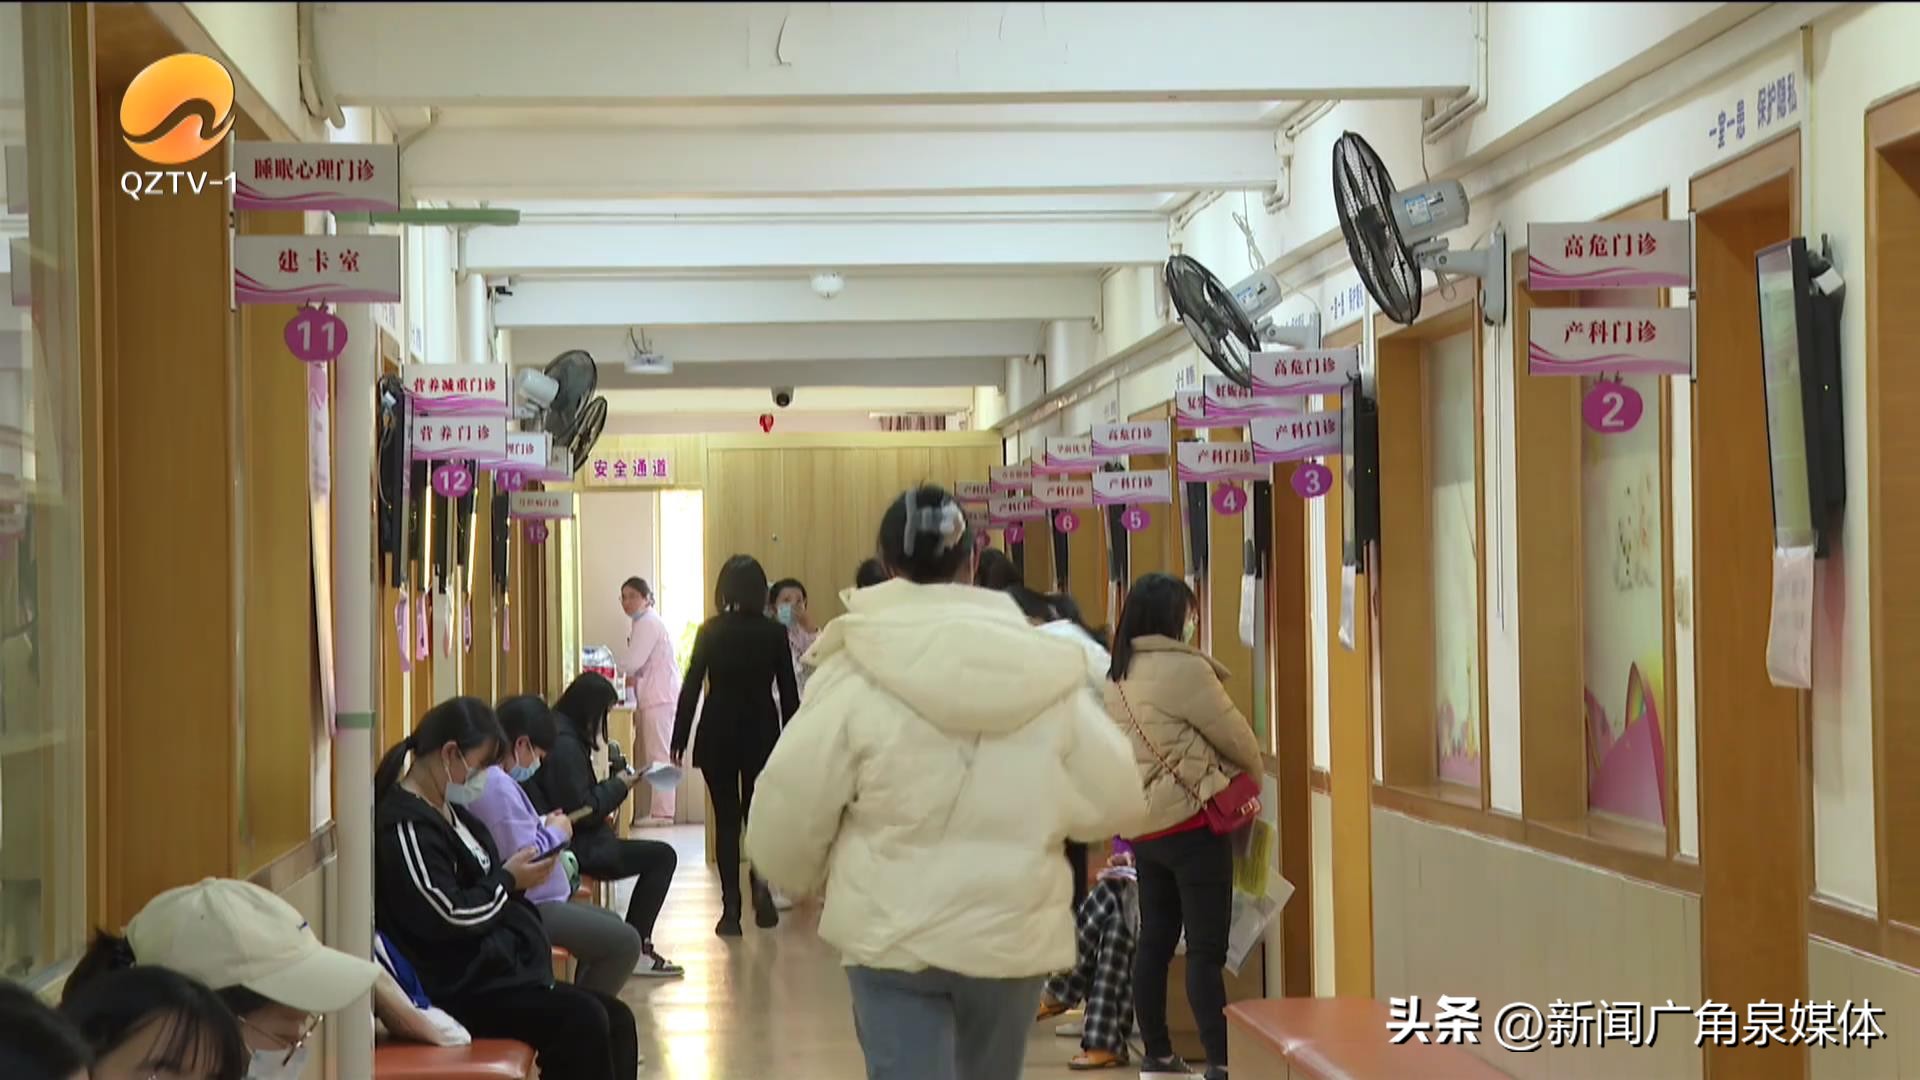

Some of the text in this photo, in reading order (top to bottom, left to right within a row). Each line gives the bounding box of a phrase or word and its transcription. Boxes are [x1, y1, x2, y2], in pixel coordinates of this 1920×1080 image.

[254, 158, 375, 182] 睡眠心理门诊
[1564, 233, 1657, 258] 高危门诊
[278, 249, 360, 273] 建卡室
[296, 320, 336, 350] 11
[1564, 320, 1657, 345] 产科门诊
[1274, 357, 1336, 376] 高危门诊
[413, 377, 497, 393] 营养减重门诊
[1601, 392, 1625, 427] 2
[420, 425, 490, 442] 营养门诊
[1275, 418, 1336, 440] 产科门诊
[1197, 447, 1251, 466] 产科门诊
[502, 471, 520, 487] 14
[594, 458, 667, 479] 安全通道
[440, 471, 466, 491] 12
[1108, 476, 1153, 490] 产科门诊
[1305, 470, 1321, 494] 3
[1223, 491, 1237, 512] 4
[1062, 514, 1073, 532] 6
[1130, 512, 1142, 533] 5
[1011, 527, 1019, 543] 7
